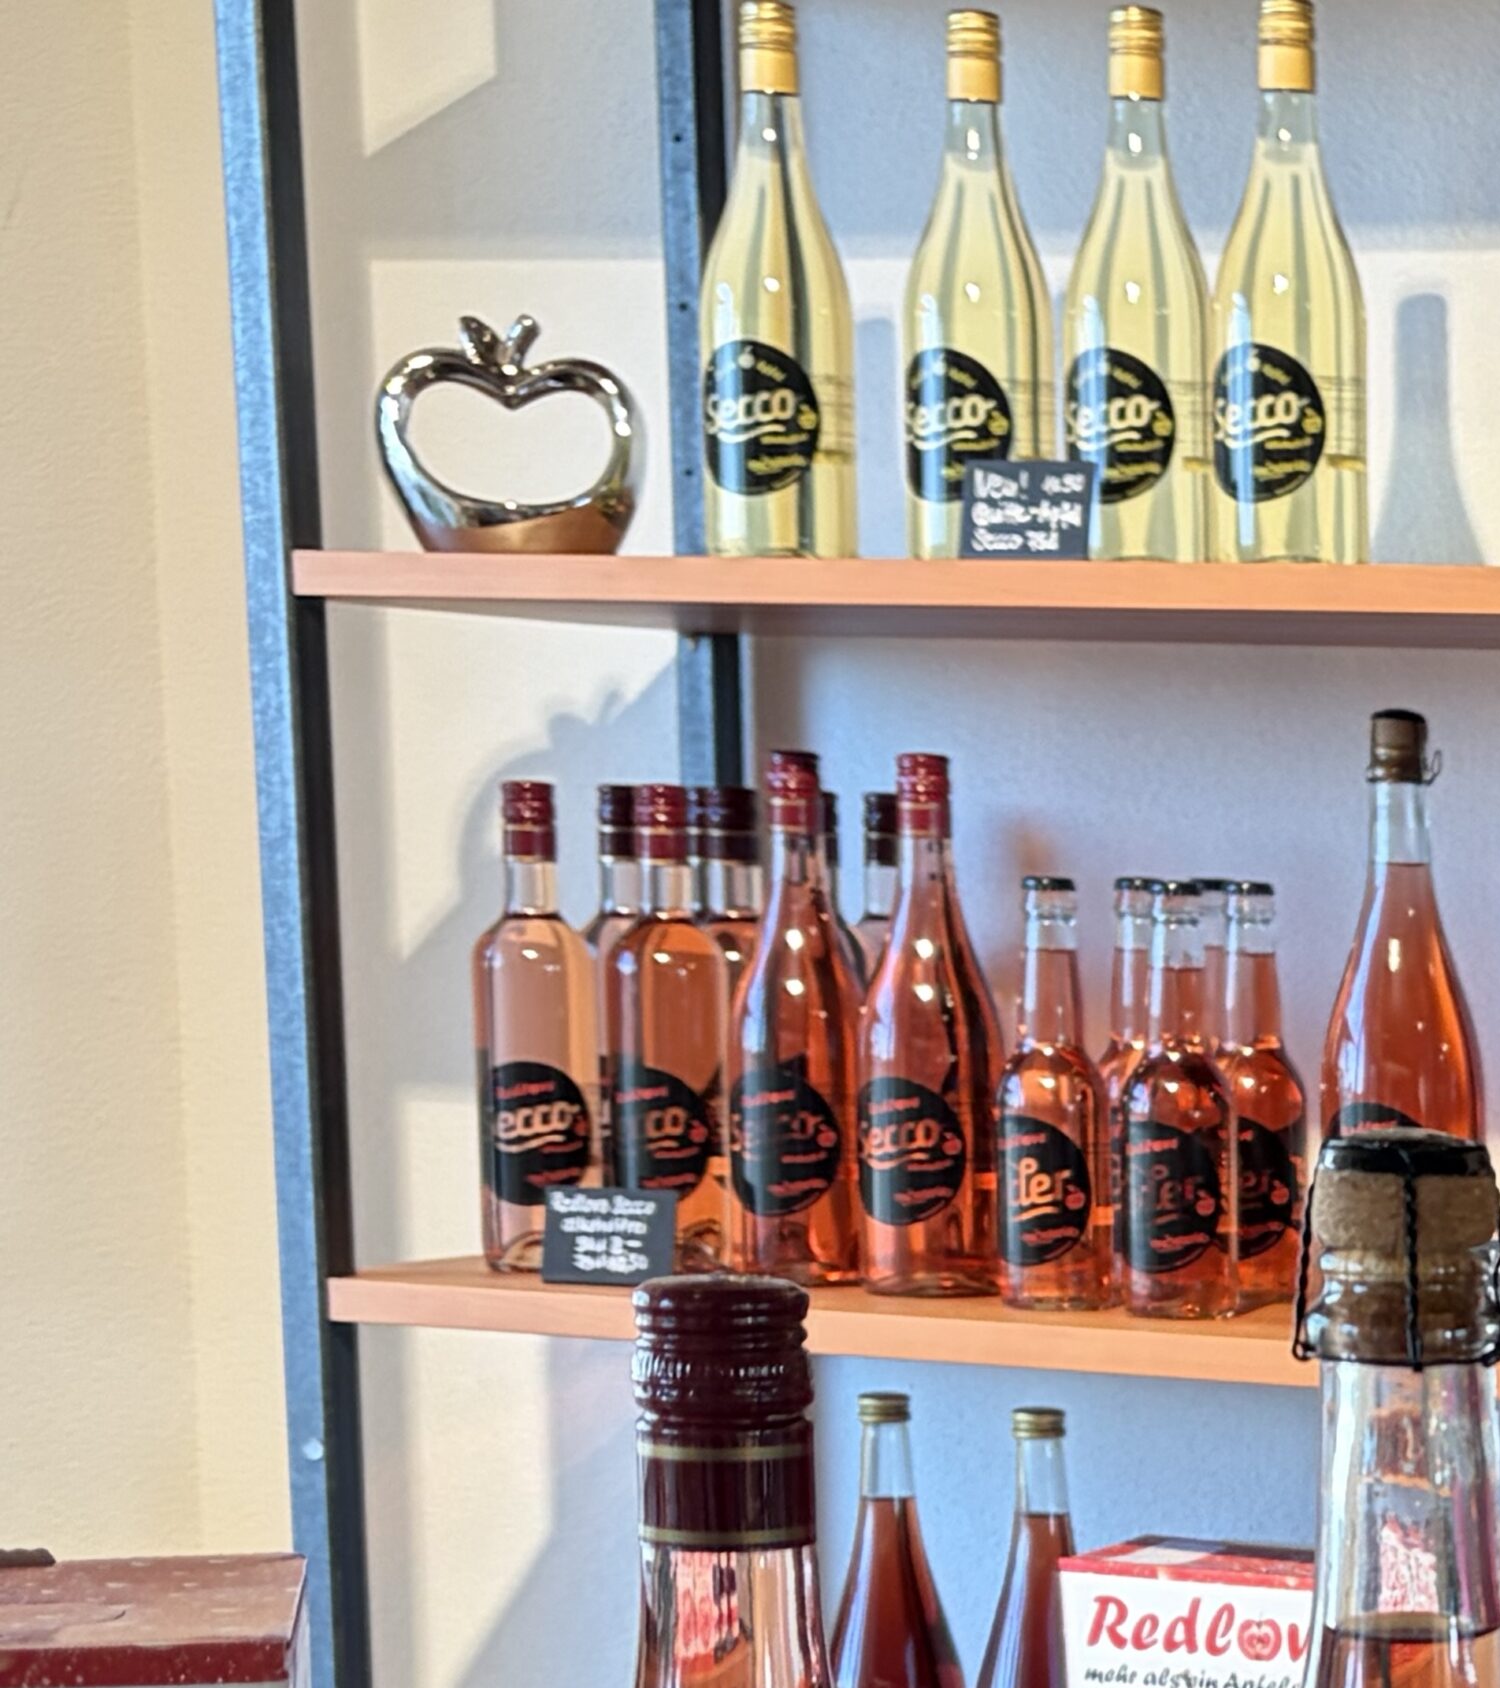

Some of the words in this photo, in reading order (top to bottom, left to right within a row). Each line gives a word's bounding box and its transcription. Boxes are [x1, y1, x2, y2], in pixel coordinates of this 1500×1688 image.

[497, 1101, 581, 1140] ecco
[1087, 1595, 1312, 1662] Redlov
[1083, 1664, 1138, 1686] mehr
